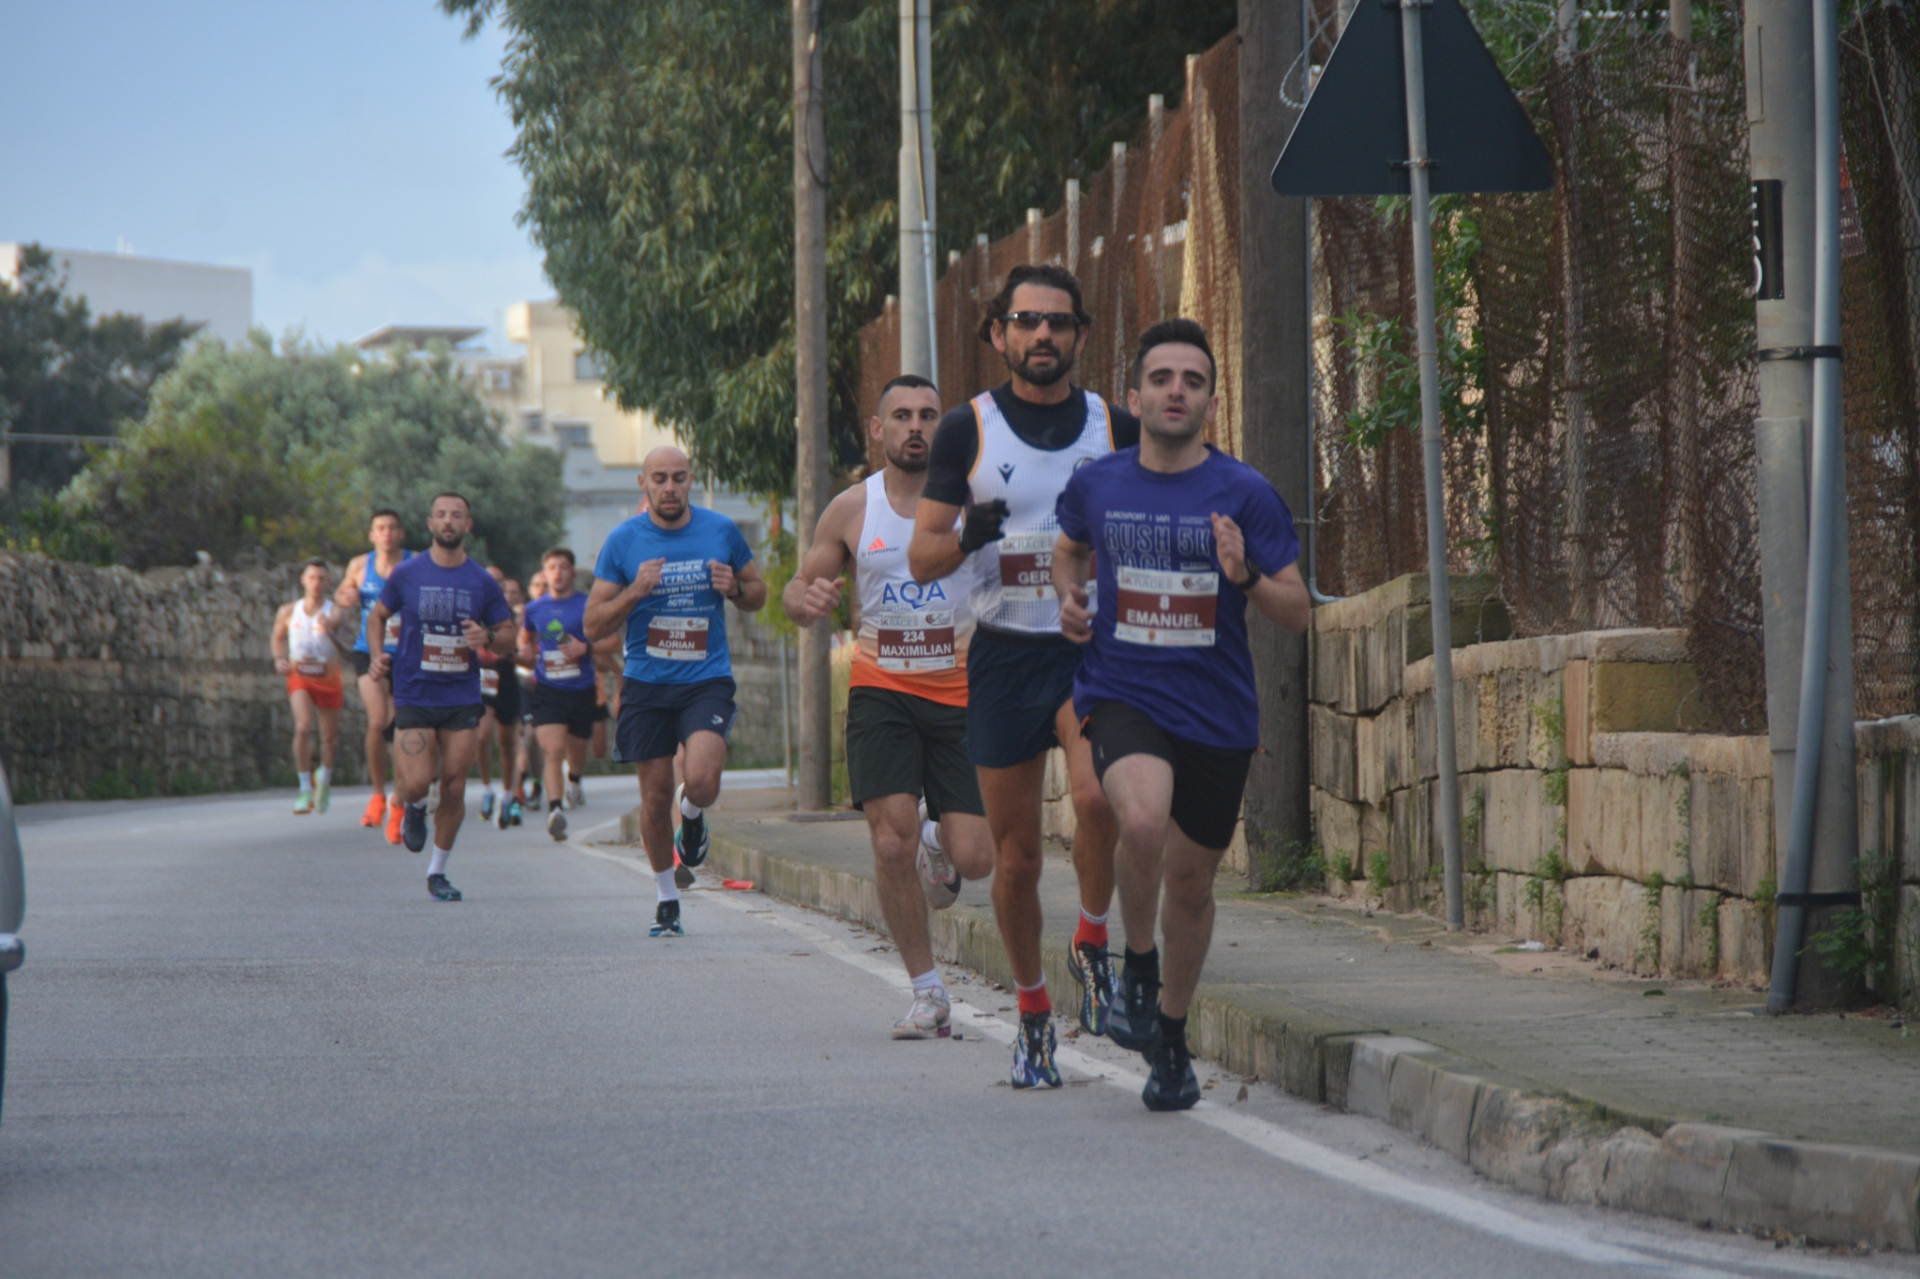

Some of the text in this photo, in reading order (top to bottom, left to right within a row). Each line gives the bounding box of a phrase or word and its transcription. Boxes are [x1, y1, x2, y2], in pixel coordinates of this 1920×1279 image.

[1104, 521, 1211, 557] RUSH 5K
[868, 546, 900, 556] EUROSPORT
[1035, 553, 1053, 567] 32
[660, 572, 707, 586] TTRANS
[1018, 570, 1052, 584] GER
[882, 580, 947, 610] AQA
[1160, 595, 1170, 610] 8
[1126, 608, 1203, 628] EMANUEL
[903, 630, 926, 643] 234
[658, 639, 695, 650] ADRIAN
[881, 643, 952, 657] MAXIMILIAN
[429, 653, 463, 664] MICHAEL
